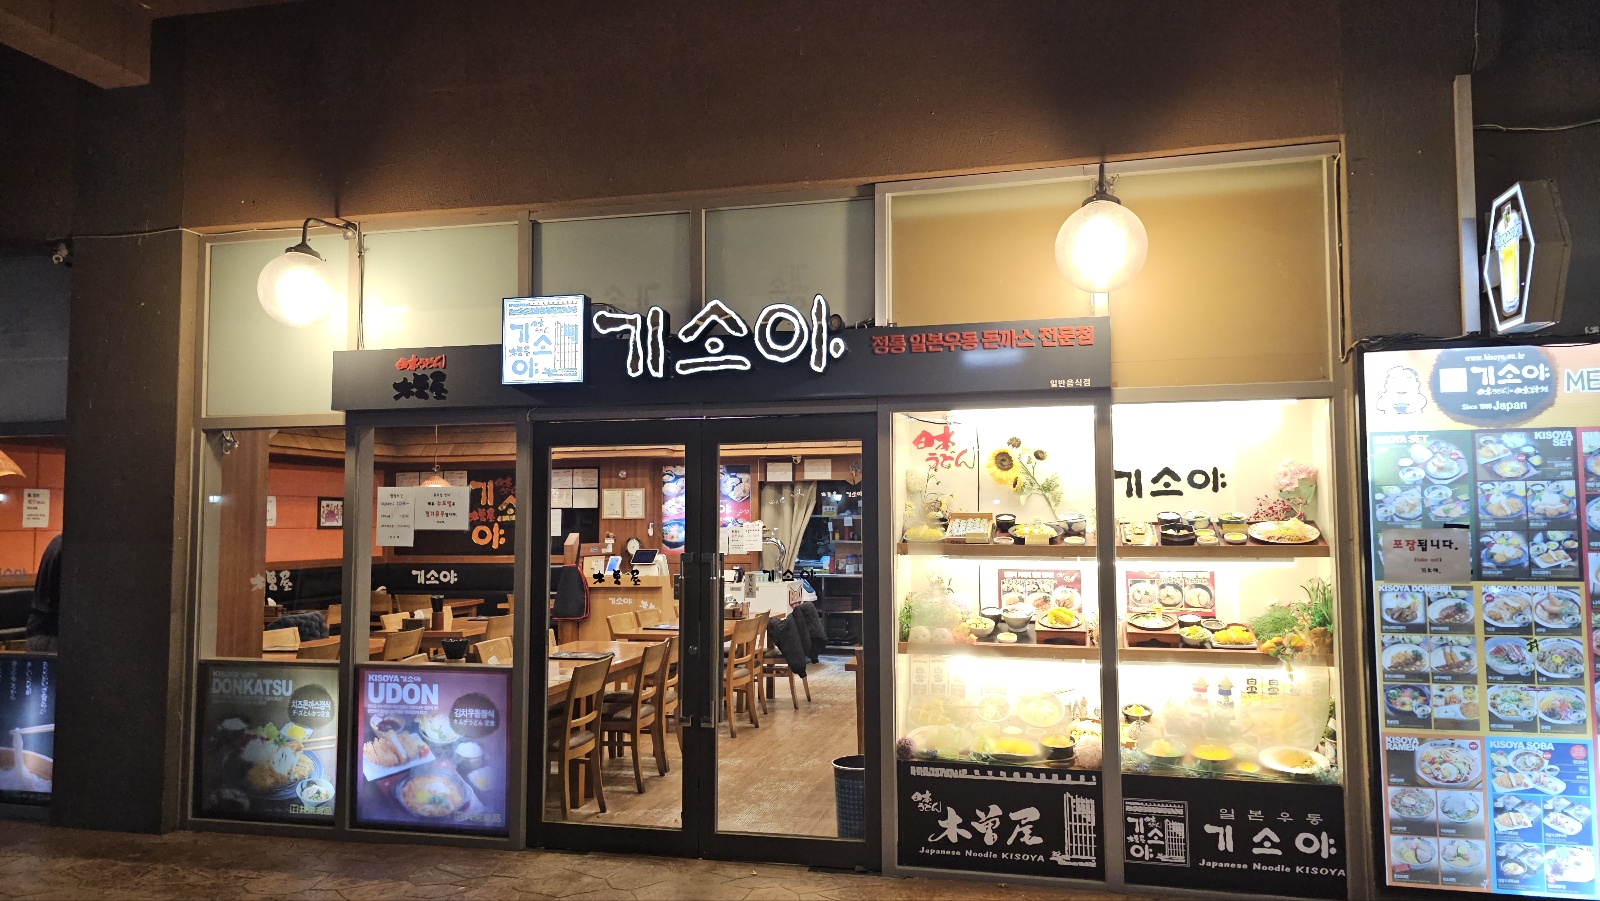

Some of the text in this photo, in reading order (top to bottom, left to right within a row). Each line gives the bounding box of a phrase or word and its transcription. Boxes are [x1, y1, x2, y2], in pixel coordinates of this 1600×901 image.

[593, 294, 846, 378] 기소야
[872, 326, 1095, 355] 정통 일본우동 돈까스 전문점
[1469, 363, 1551, 386] 기소야
[1050, 378, 1092, 389] 일반음식점
[1493, 400, 1528, 412] Japan
[1534, 430, 1573, 440] KISOYA
[1552, 439, 1573, 447] SET
[1113, 467, 1227, 499] 기소야
[412, 569, 458, 585] 기소야
[1411, 585, 1452, 593] DONBURI
[1482, 585, 1514, 593] KISOYA
[608, 597, 633, 606] 기소야
[368, 674, 421, 683] KISOYA 기소야
[210, 678, 293, 697] DONKATSU
[368, 683, 439, 705] UDON
[291, 699, 331, 710] 치즈돈까스정식
[454, 708, 495, 718] 김치우동정식
[1385, 736, 1419, 745] KISOYA
[1489, 740, 1555, 751] KISOYA SOBA
[1385, 743, 1419, 751] RAMEN
[1203, 823, 1337, 859] 기소야
[919, 846, 1045, 863] Japanese Noodle KISOYA
[1199, 858, 1346, 877] Japanese Noodle KISOYA
